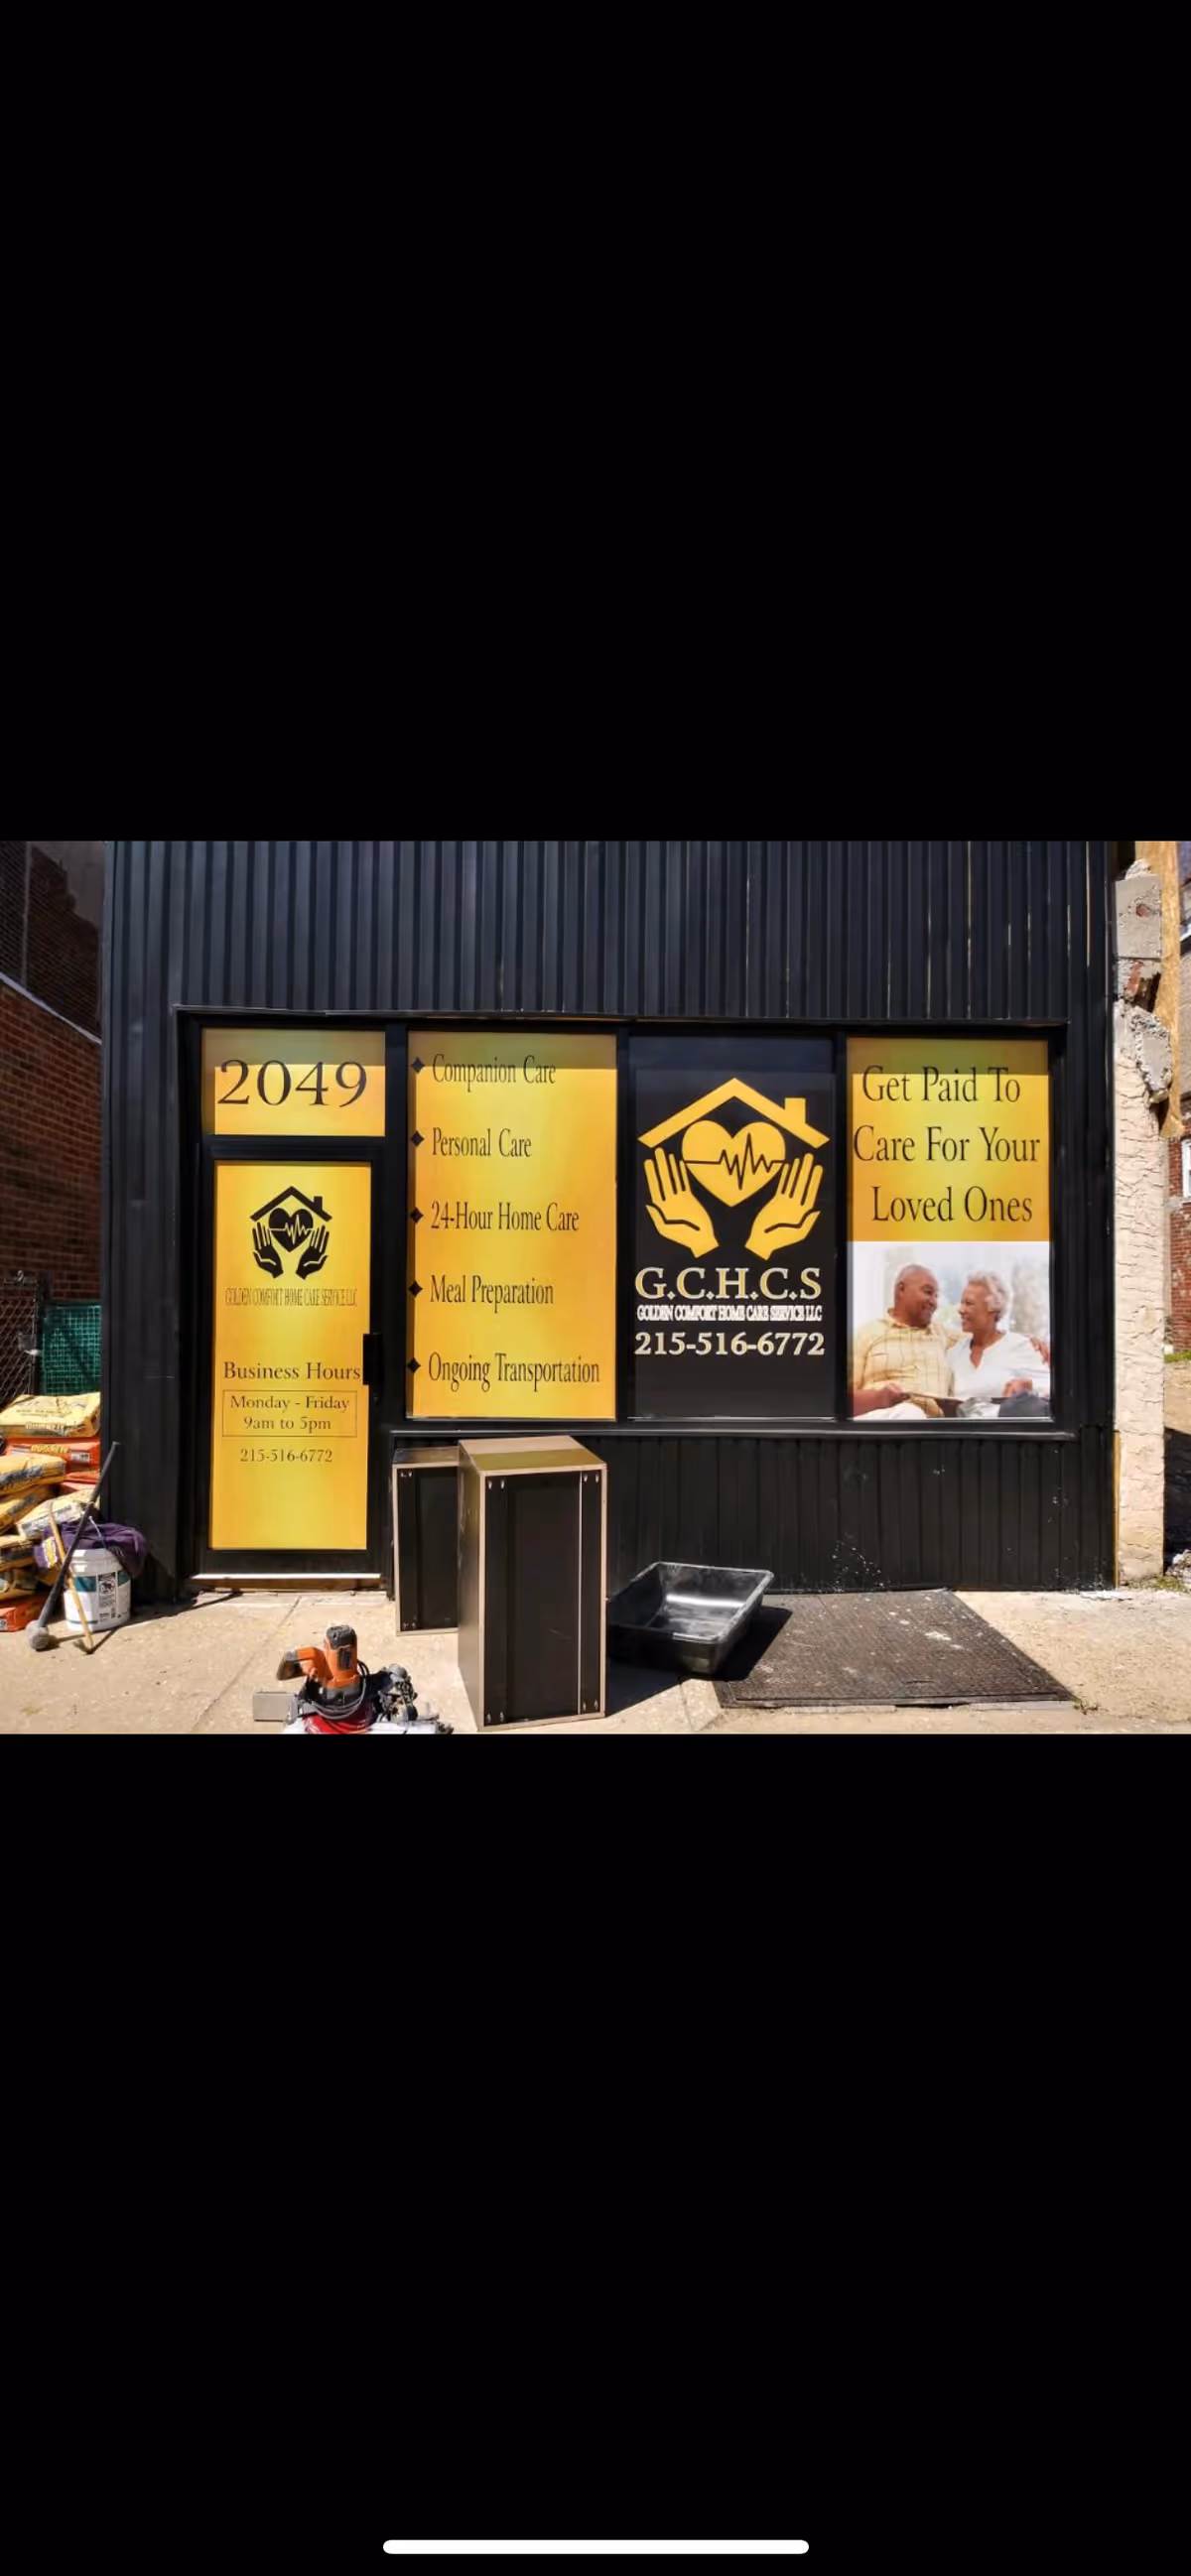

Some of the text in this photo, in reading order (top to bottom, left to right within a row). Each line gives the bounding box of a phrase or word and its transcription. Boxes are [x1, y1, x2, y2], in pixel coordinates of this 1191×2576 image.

[218, 1059, 367, 1108] 2049
[432, 1054, 556, 1093] Companion Care
[862, 1066, 1021, 1102] Get Paid To
[432, 1127, 532, 1158] Personal Care
[854, 1125, 1040, 1162] Care For Your
[431, 1201, 579, 1231] 24-Hour Home Care
[872, 1186, 1032, 1223] Loved Ones
[430, 1274, 554, 1314] Meal Preparation
[635, 1266, 822, 1301] G.C.H.C.S
[636, 1305, 823, 1322] GOLDEN COMFORT HOME CARE SERVICE LLC
[634, 1332, 826, 1355] 215-516-6772
[223, 1361, 360, 1380] Business Hours
[429, 1352, 600, 1393] Ongoing Transportation
[230, 1395, 290, 1413] Monday
[306, 1395, 350, 1413] Friday
[243, 1416, 331, 1434] 9am to 5pm
[239, 1449, 333, 1463] 215-516-6772
